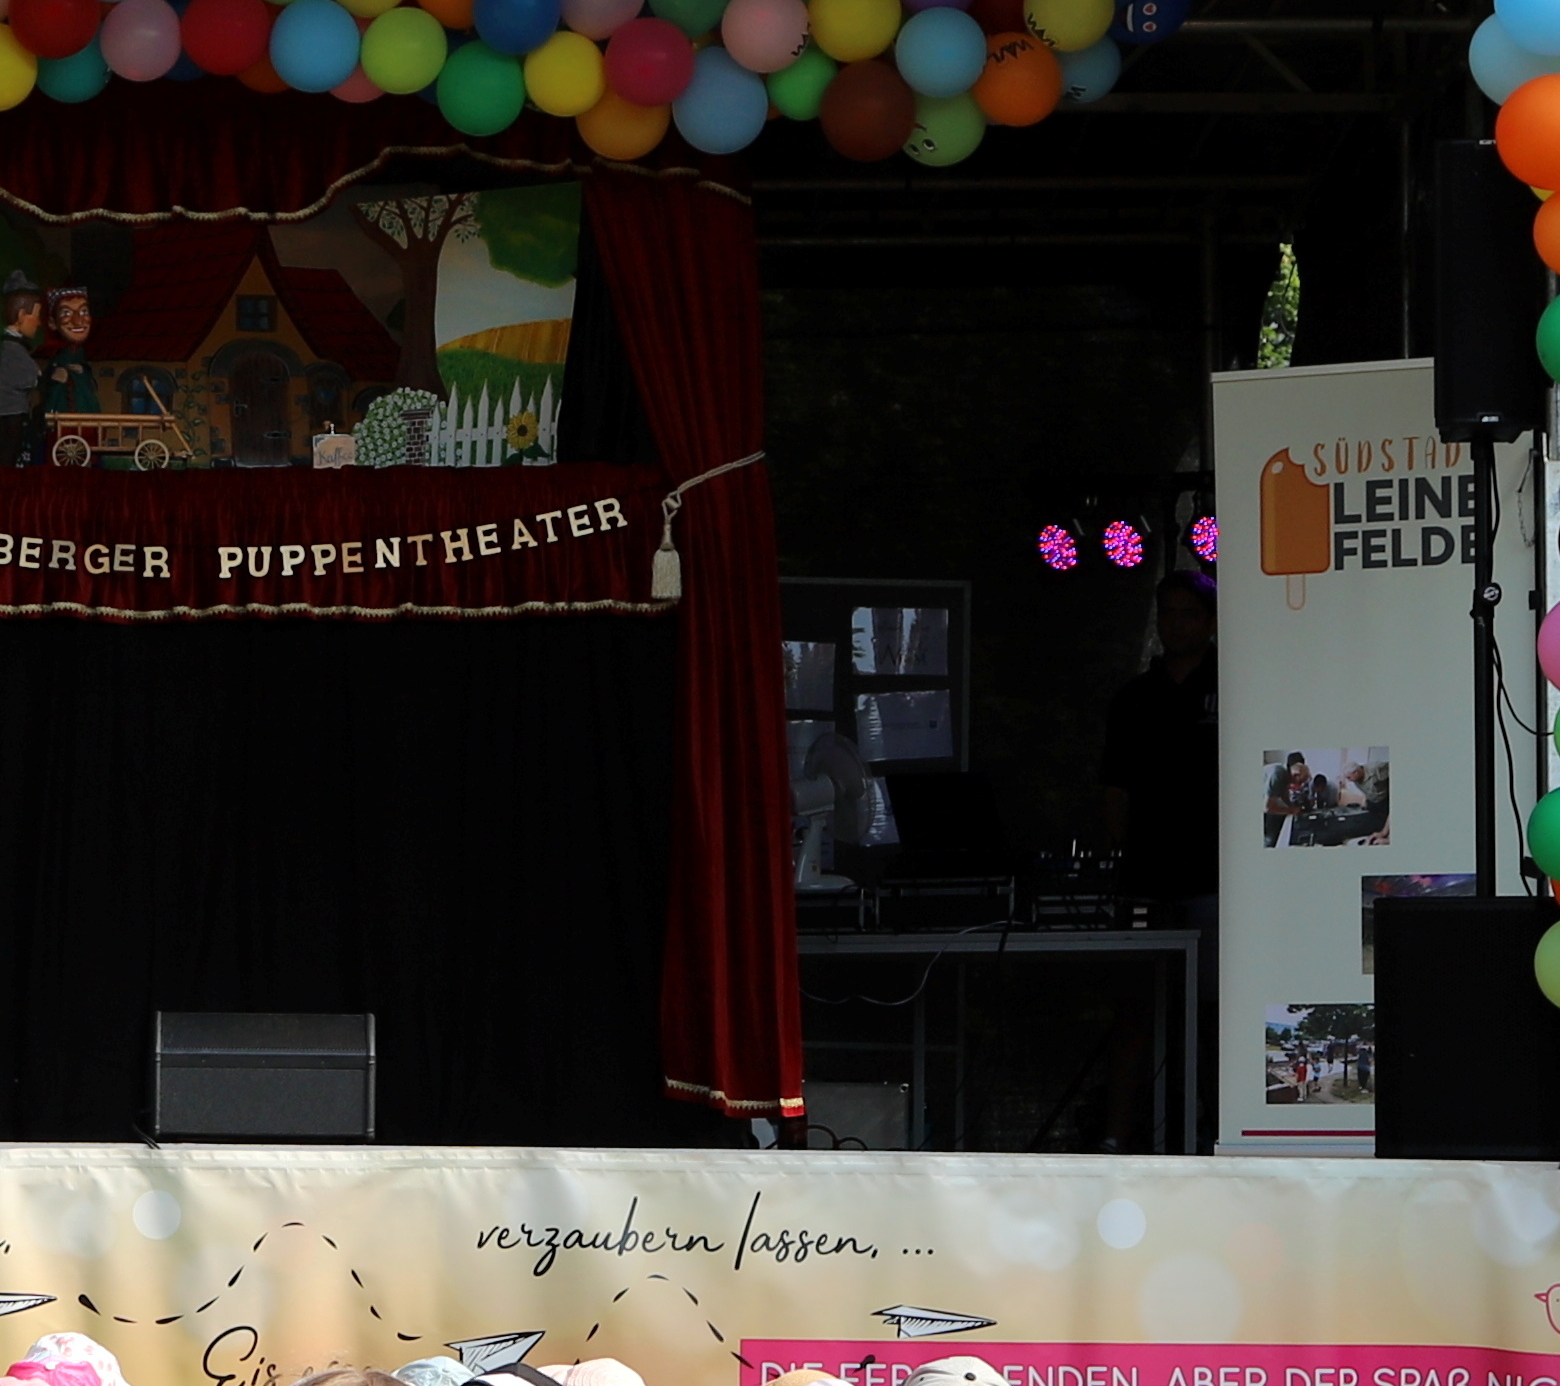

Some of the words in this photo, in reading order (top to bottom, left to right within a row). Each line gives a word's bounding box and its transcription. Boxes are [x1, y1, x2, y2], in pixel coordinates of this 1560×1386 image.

[1313, 435, 1475, 478] SÜDSTAD
[218, 497, 628, 580] PUPPENTHEATER
[477, 1196, 724, 1276] verzaubern
[733, 1191, 879, 1270] lassen,
